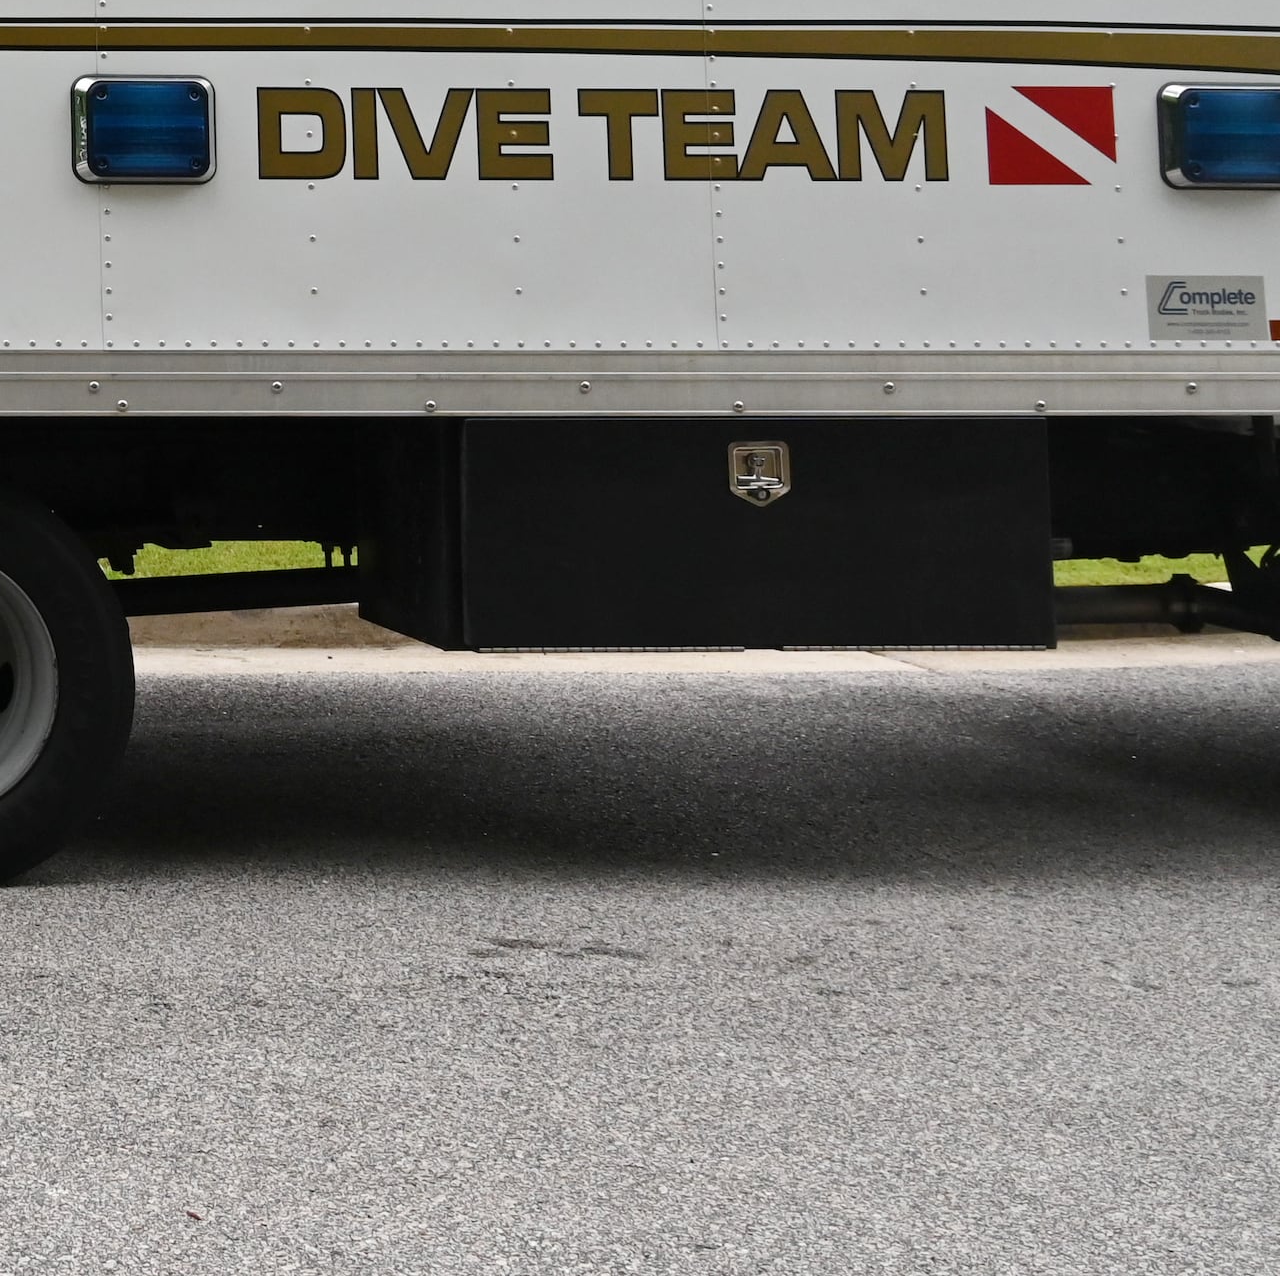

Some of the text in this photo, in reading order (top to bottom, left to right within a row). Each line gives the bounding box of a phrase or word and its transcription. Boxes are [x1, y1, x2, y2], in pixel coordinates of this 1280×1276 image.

[257, 87, 949, 181] DIVE TEAM
[1158, 281, 1256, 315] Complete
